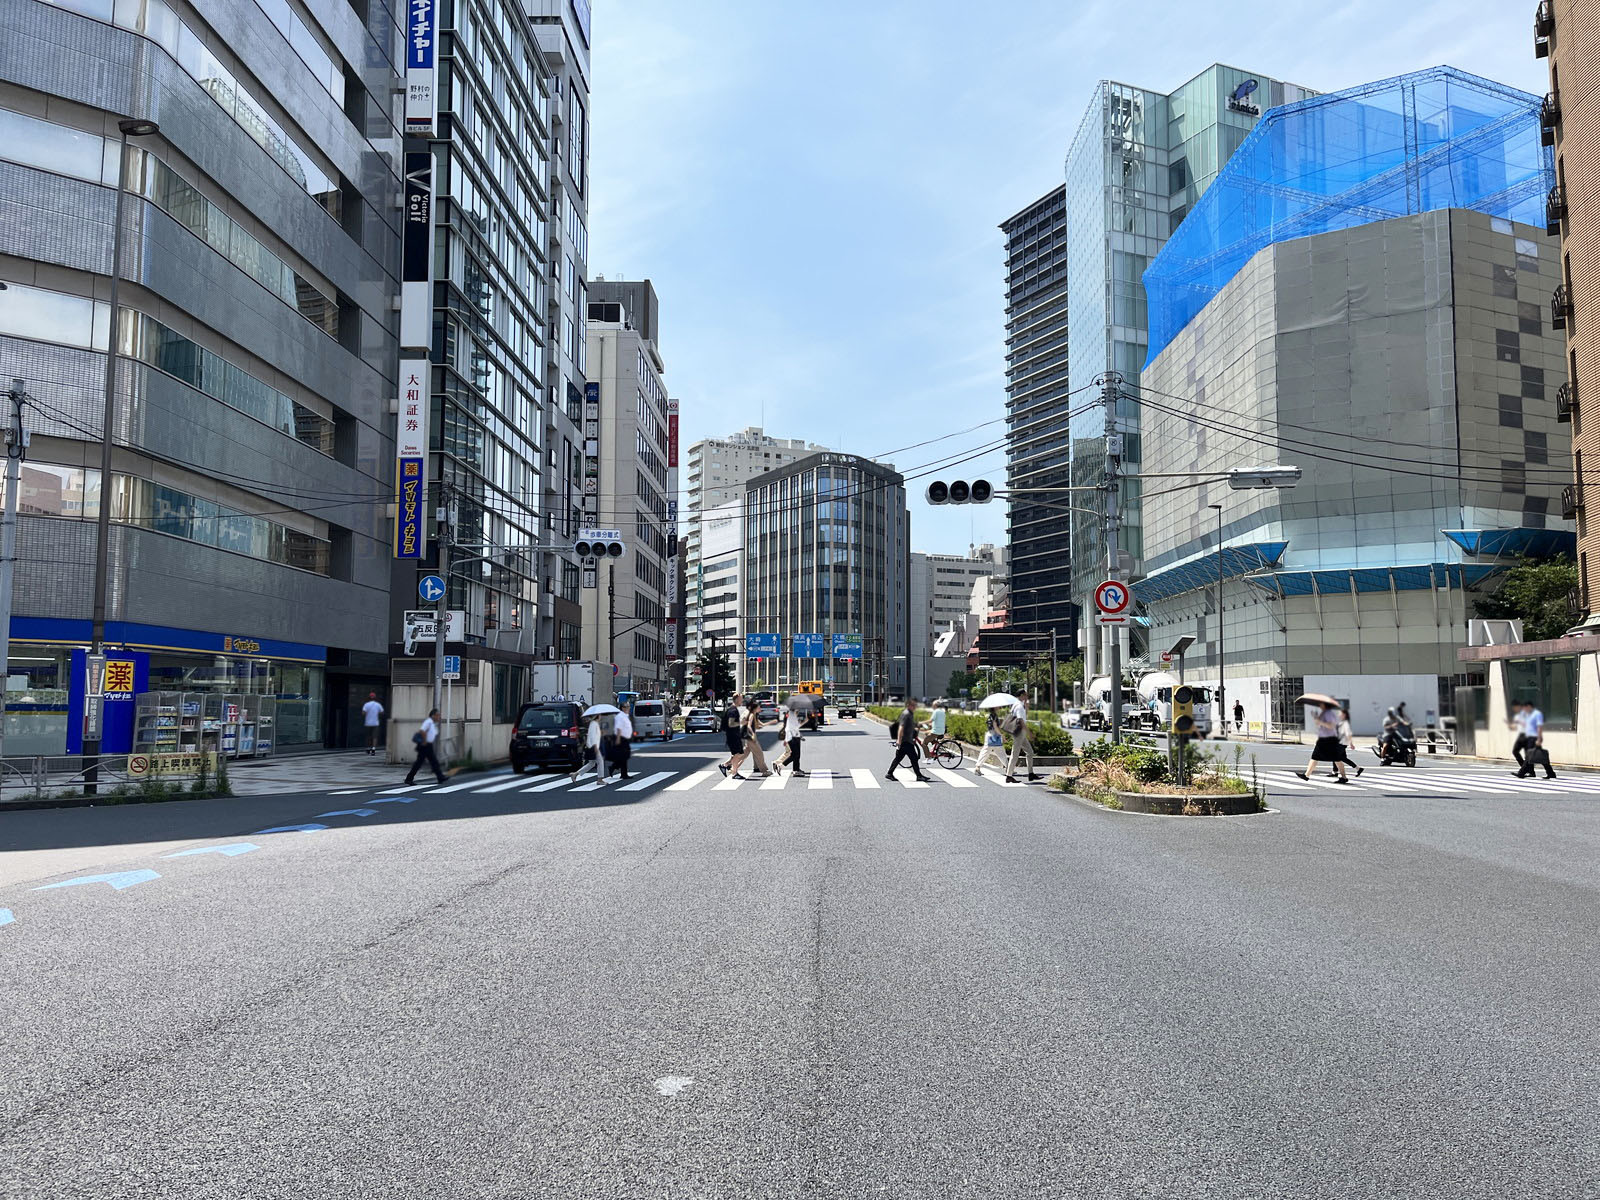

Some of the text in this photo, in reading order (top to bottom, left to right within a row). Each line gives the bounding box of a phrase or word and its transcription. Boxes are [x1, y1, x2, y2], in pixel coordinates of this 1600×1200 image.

[410, 194, 421, 222] Golf
[405, 374, 419, 432] 大和証券
[405, 463, 418, 476] 薬
[107, 662, 131, 691] 薬
[150, 759, 211, 768] 路上喫煙禁止
